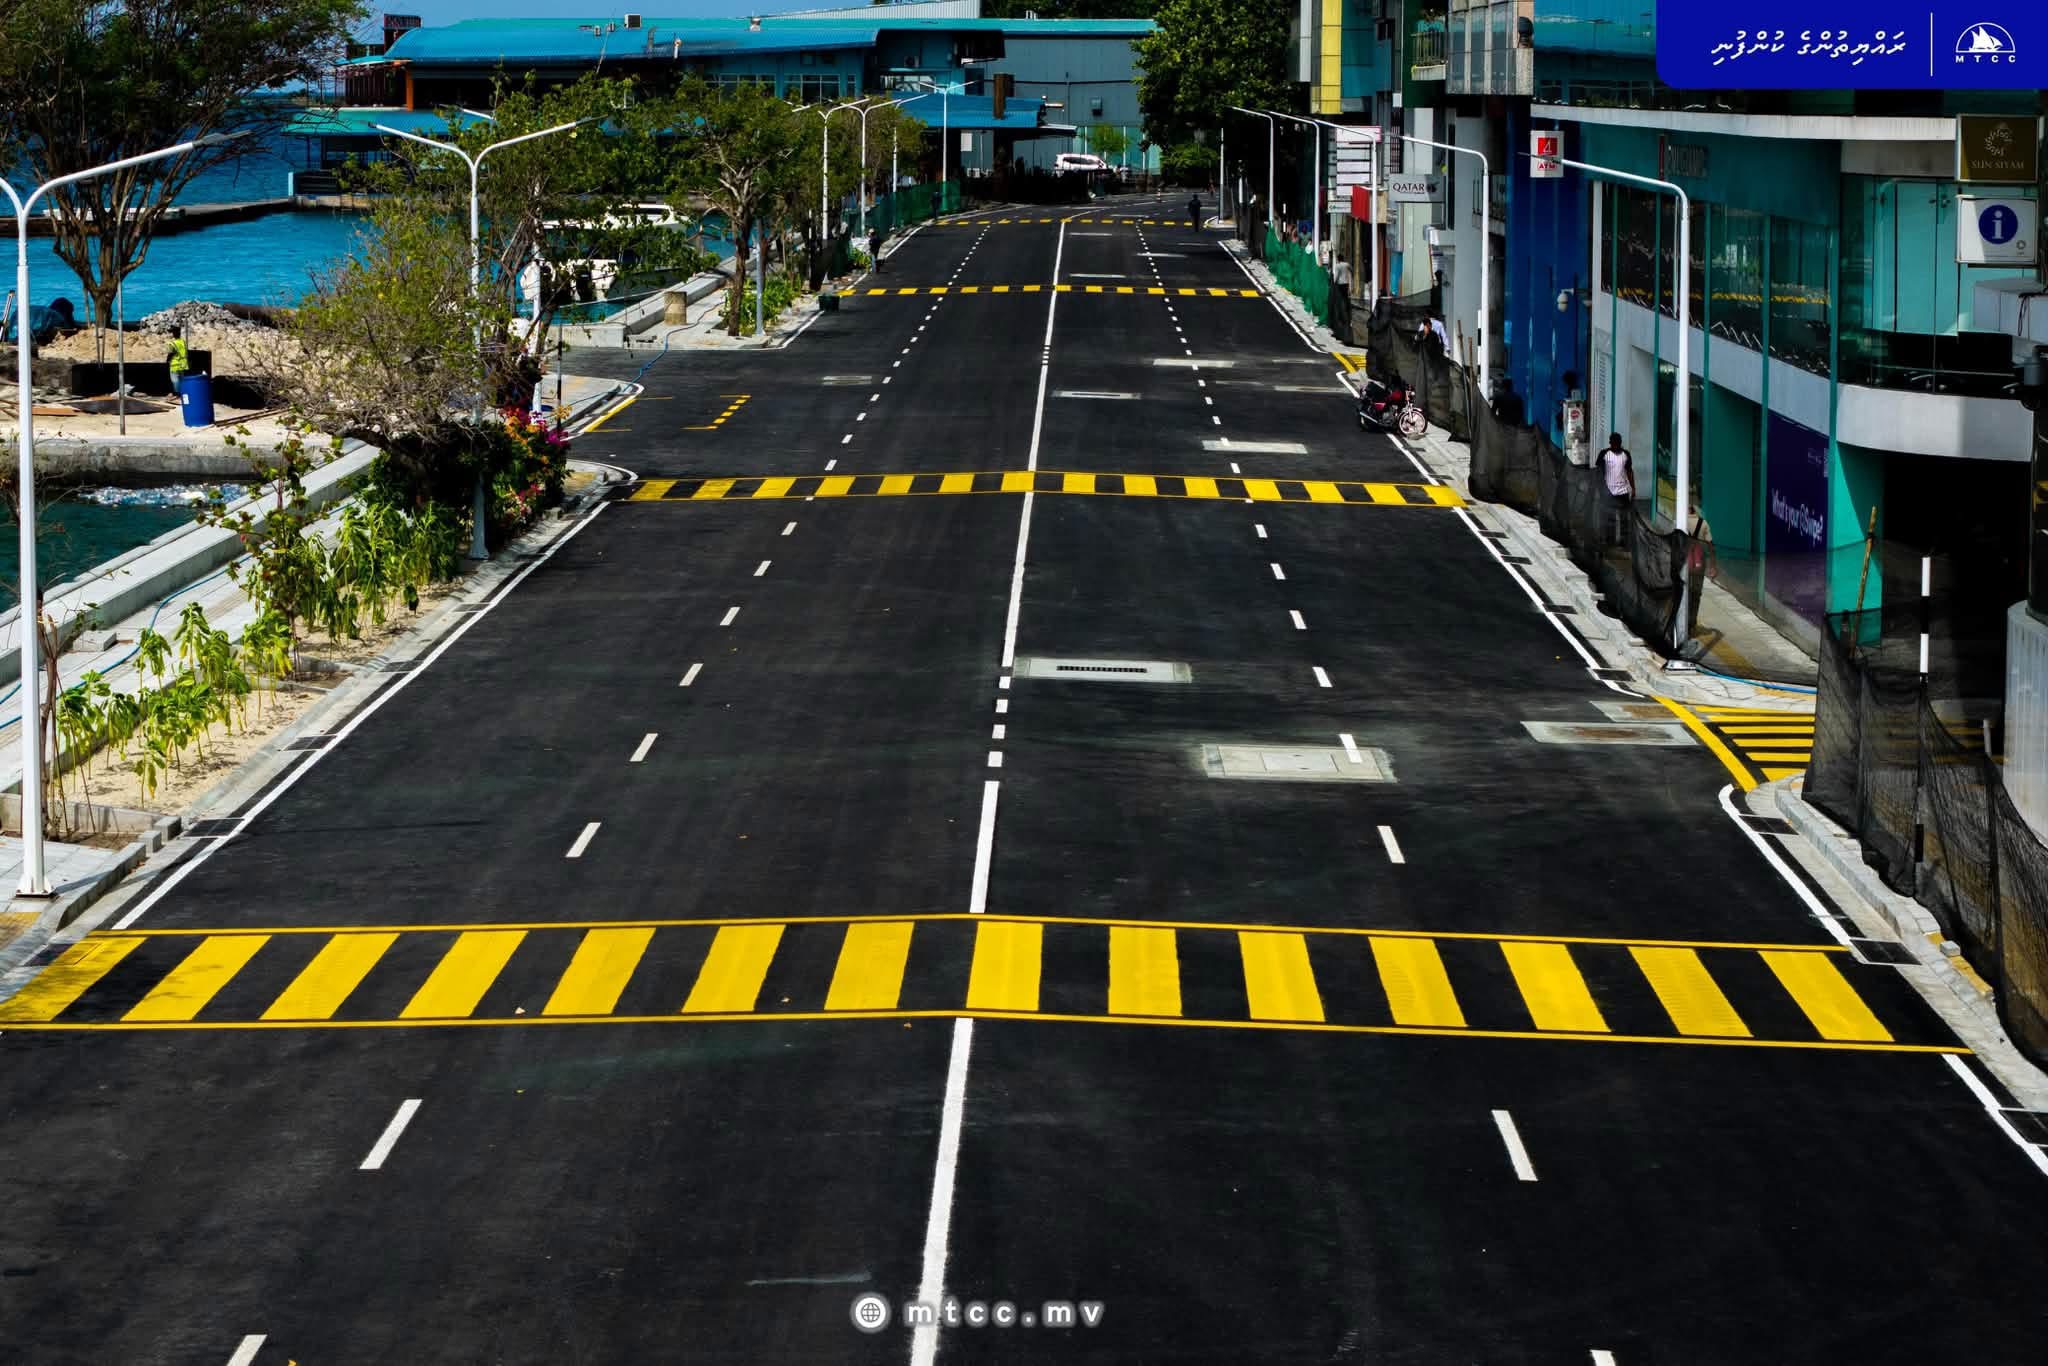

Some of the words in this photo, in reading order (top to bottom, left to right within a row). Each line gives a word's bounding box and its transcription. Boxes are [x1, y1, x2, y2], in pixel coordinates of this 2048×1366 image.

[1971, 160, 1992, 169] SUN
[1993, 160, 2025, 169] SIYAM
[1392, 182, 1425, 192] QATAR
